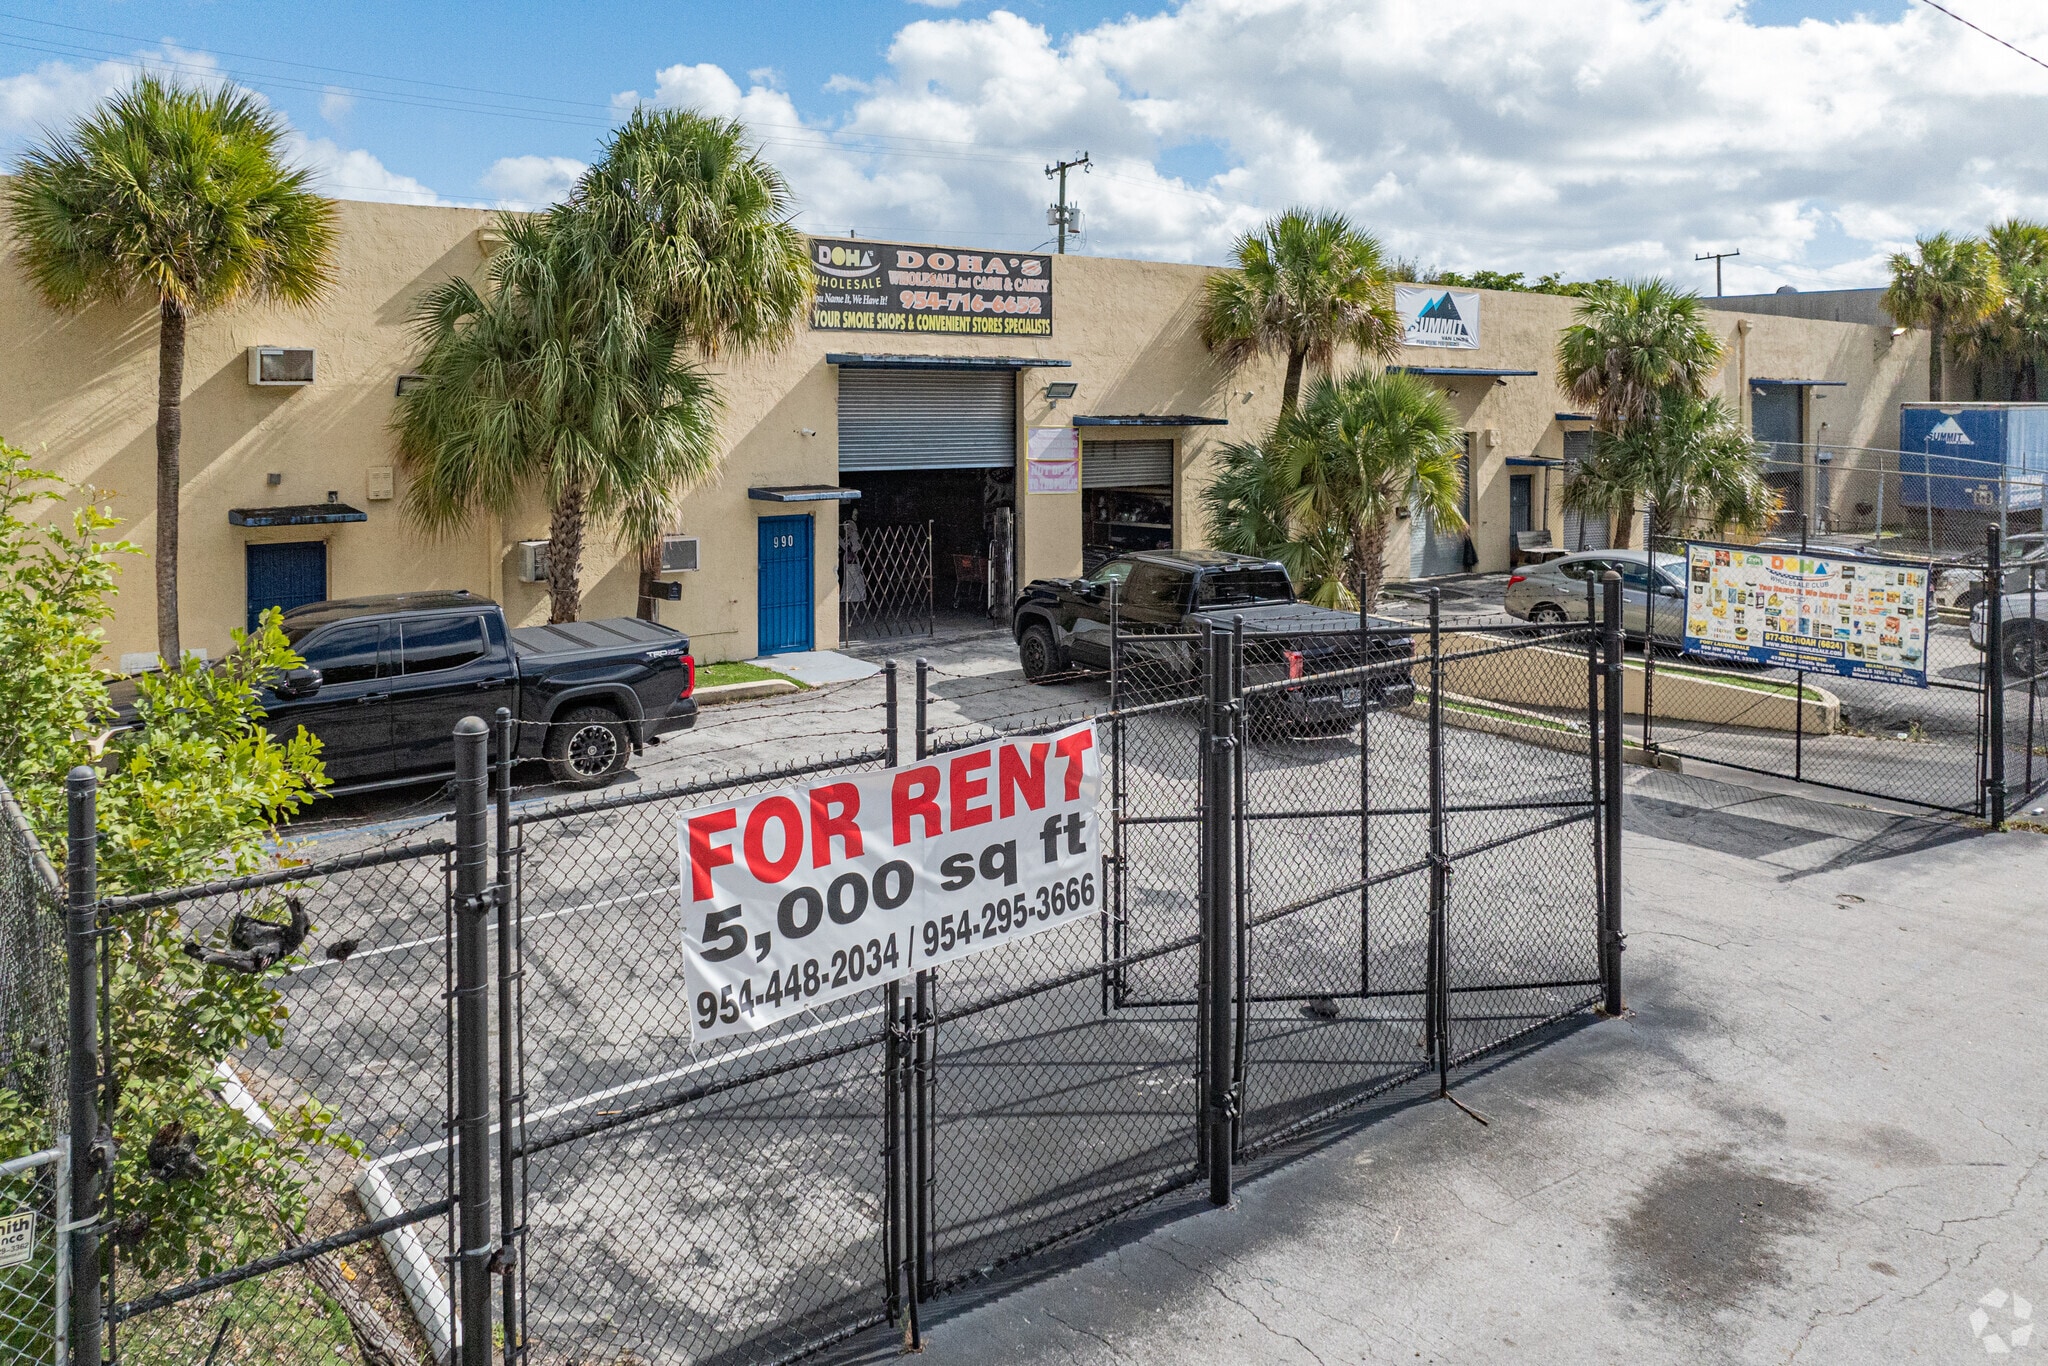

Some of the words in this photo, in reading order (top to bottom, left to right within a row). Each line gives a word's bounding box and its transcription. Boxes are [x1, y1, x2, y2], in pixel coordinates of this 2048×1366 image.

[818, 245, 874, 267] DOHA'S
[896, 250, 1043, 277] DOHA'S
[813, 274, 882, 290] WHOLESALE
[888, 270, 957, 289] WHOLESALE
[1004, 277, 1013, 291] &
[824, 292, 844, 304] Name
[852, 294, 862, 304] We
[863, 294, 879, 305] Have
[879, 295, 888, 305] It!
[900, 290, 1042, 315] 954-716-6652
[813, 309, 840, 328] YOUR
[842, 310, 875, 329] SMOKE
[876, 312, 906, 330] SHOPS
[908, 313, 914, 330] &
[916, 313, 971, 333] CONVENIENT
[972, 316, 1003, 334] STORES
[1004, 317, 1051, 335] SPECIALISTS
[1409, 317, 1465, 336] SUMMIT
[1928, 432, 1964, 441] SUMMIT
[773, 534, 793, 548] 990
[1770, 576, 1810, 588] WHOLESALE
[687, 782, 864, 903] FOR
[890, 728, 1093, 847] RENT
[699, 859, 915, 963] 5,000
[939, 839, 1019, 891] sq
[1039, 811, 1087, 863] ft
[696, 932, 899, 1029] 954-448-2034
[907, 925, 915, 967] /
[923, 872, 1095, 957] 954-295-3666
